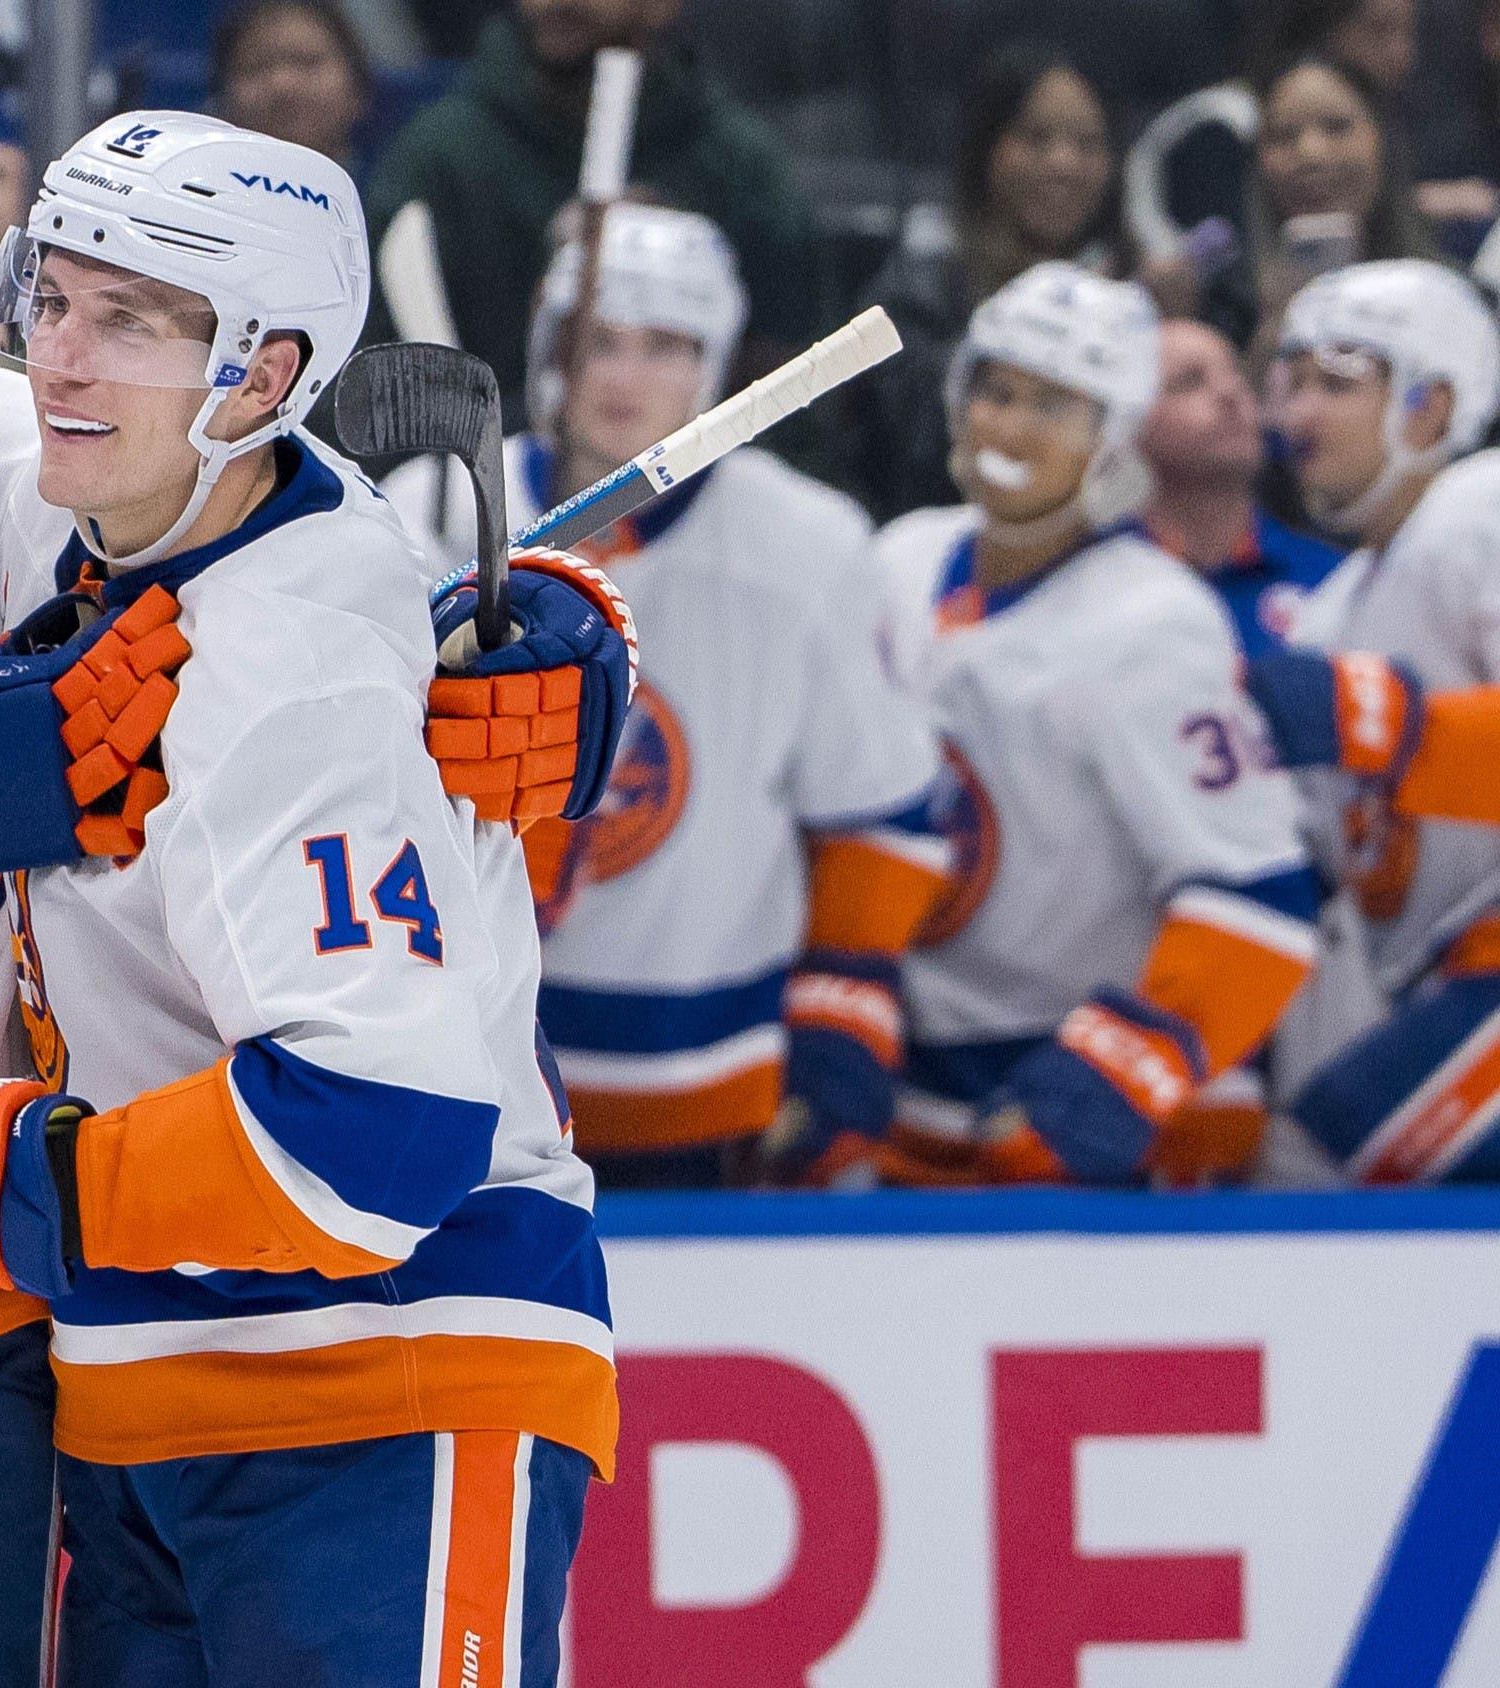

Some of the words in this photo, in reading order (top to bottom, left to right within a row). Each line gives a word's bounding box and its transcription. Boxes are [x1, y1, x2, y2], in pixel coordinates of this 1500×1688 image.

[65, 165, 134, 197] WARRIOR
[229, 171, 330, 211] VIAM
[302, 832, 444, 968] 14
